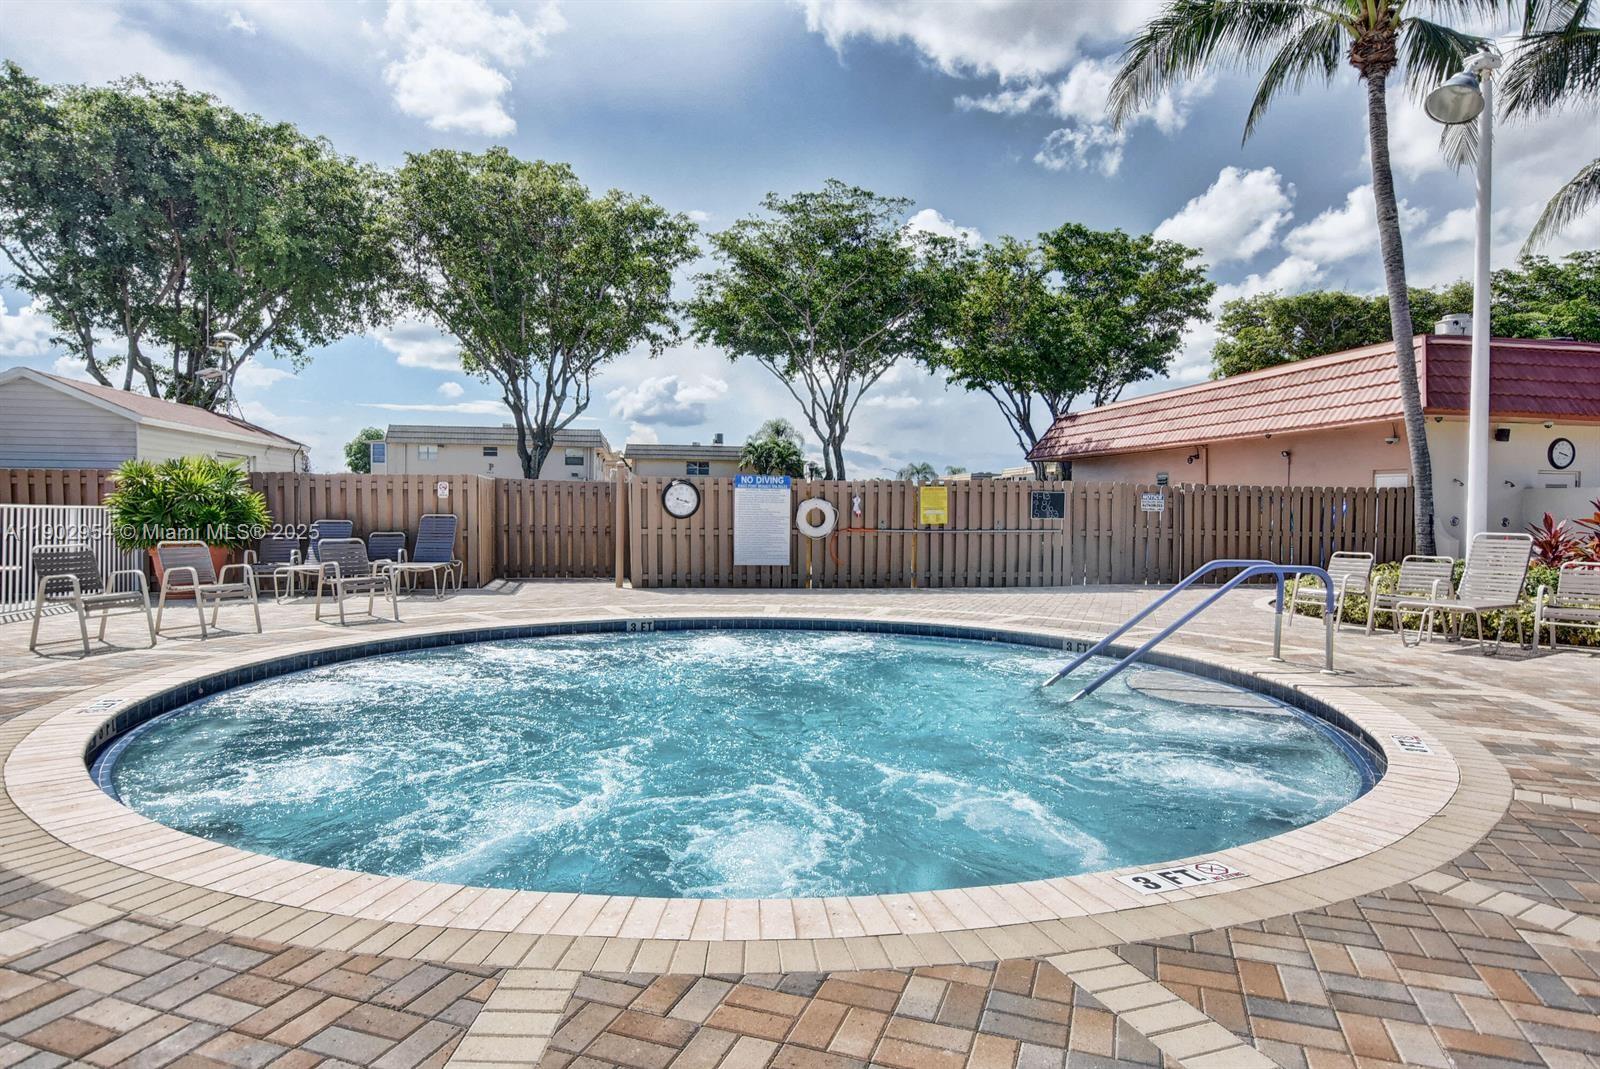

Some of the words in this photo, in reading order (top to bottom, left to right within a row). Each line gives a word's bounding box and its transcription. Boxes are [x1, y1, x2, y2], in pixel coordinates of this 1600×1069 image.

[741, 476, 753, 484] NO
[756, 476, 784, 484] DIVING
[630, 622, 637, 632] 3
[641, 621, 653, 632] FT
[1066, 641, 1073, 651] 3
[1076, 642, 1088, 653] FT
[1132, 876, 1162, 890] 3
